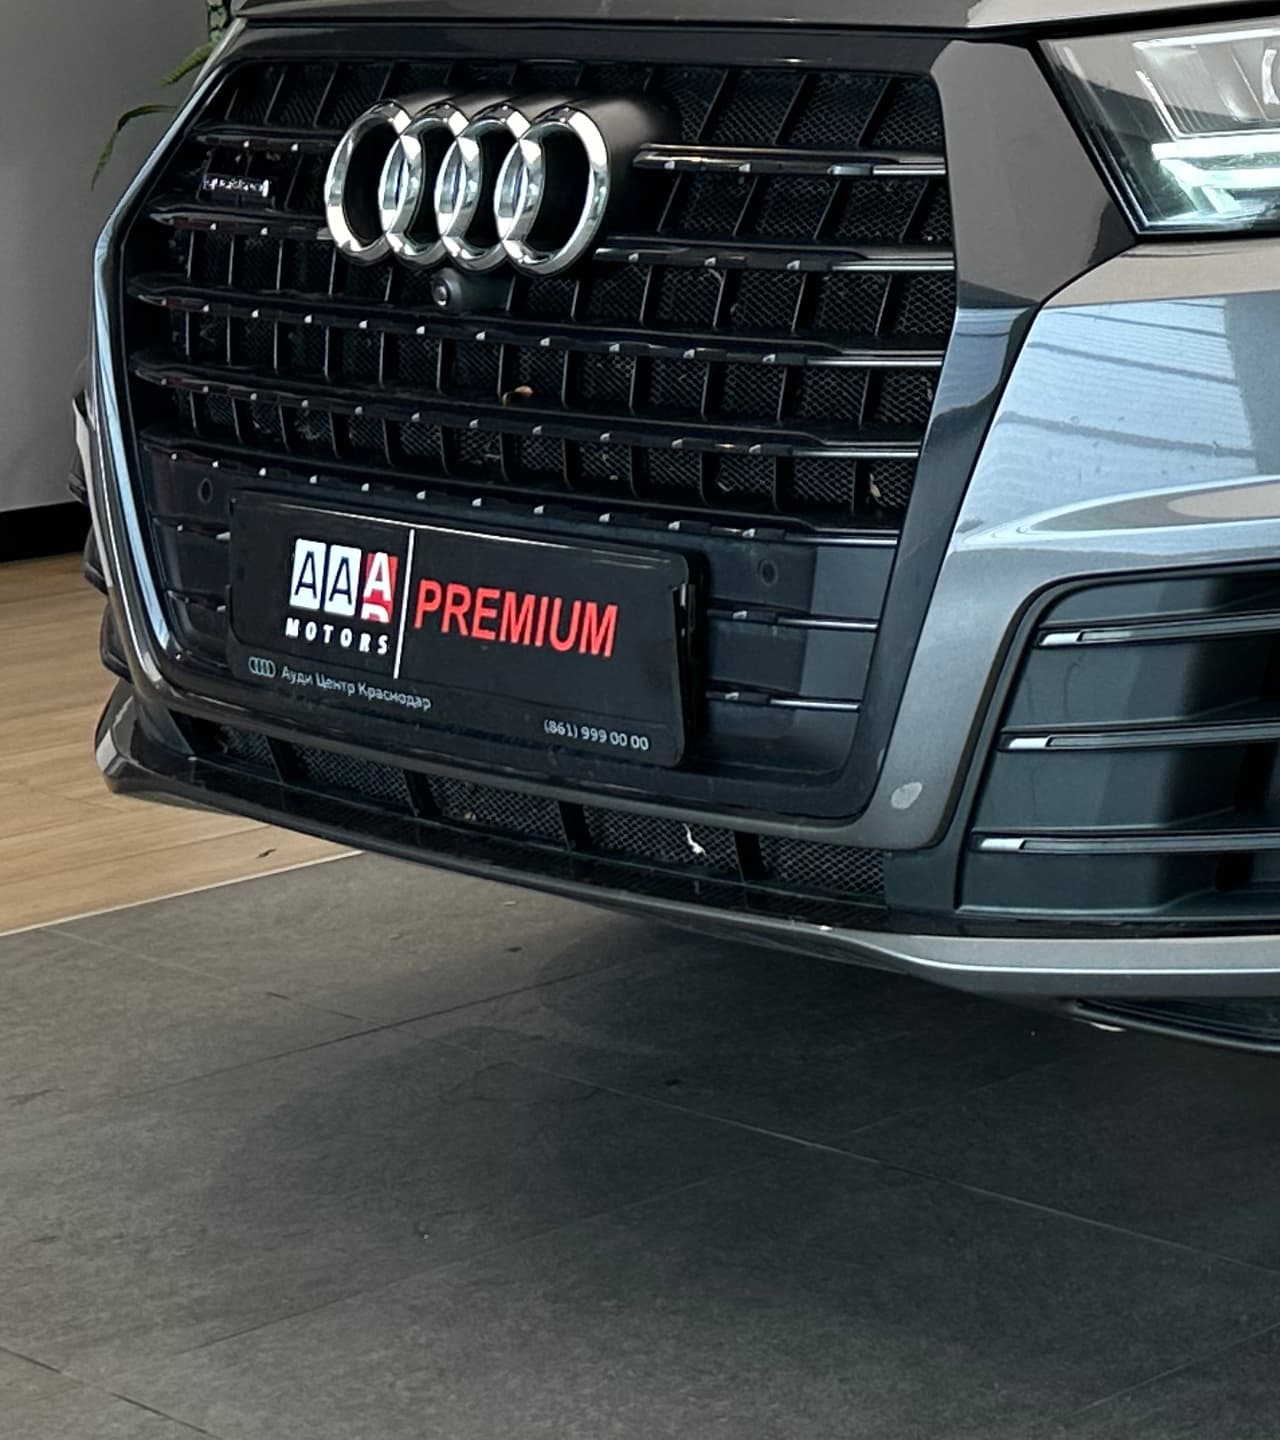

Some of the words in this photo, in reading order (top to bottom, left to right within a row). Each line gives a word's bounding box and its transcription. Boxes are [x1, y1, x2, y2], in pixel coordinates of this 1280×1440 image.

[284, 616, 390, 656] MOTORS
[413, 578, 620, 658] PREMIUM
[281, 665, 314, 686] Ауди
[315, 671, 355, 696] Центр
[357, 681, 432, 711] Краснодар
[543, 719, 578, 739] (861)
[580, 726, 607, 743] 999
[609, 731, 628, 747] 00
[630, 735, 650, 751] 00
